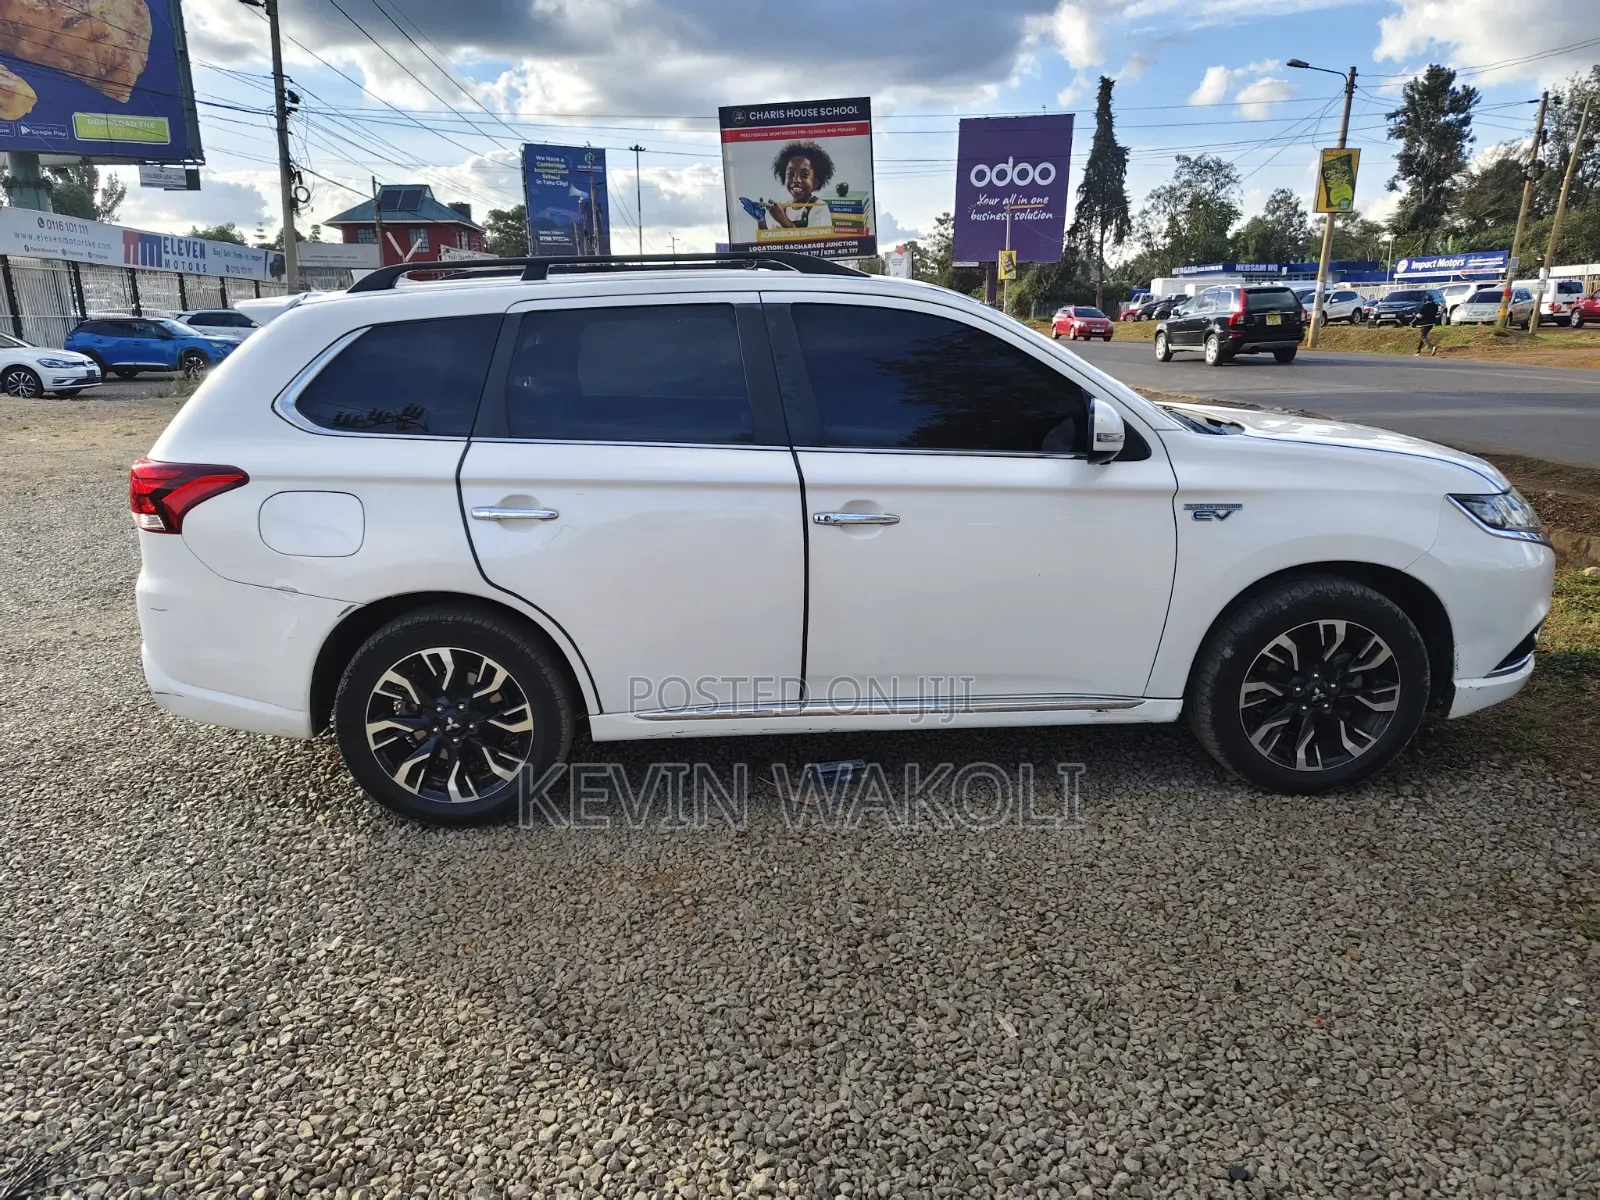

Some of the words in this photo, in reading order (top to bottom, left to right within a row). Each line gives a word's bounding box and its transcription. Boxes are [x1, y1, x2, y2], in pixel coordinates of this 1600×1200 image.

[750, 109, 784, 120] CHARIS
[787, 108, 818, 118] HOUSE
[820, 106, 859, 116] SCHOOL
[88, 118, 136, 127] DOWNLOAD
[970, 156, 1056, 187] odoo
[977, 194, 999, 206] Your
[1002, 194, 1016, 205] all
[1018, 194, 1027, 204] in
[1030, 195, 1049, 204] one
[970, 209, 1012, 221] business
[1014, 207, 1053, 220] solution
[46, 219, 64, 231] 0116
[66, 222, 78, 232] 101
[78, 224, 88, 234] 111
[760, 230, 800, 238] ADMISSIONS
[163, 236, 206, 259] ELEVEN
[164, 259, 206, 272] MOTORS
[1411, 260, 1436, 270] Impact
[1437, 258, 1465, 267] Motors
[1192, 510, 1234, 521] EV
